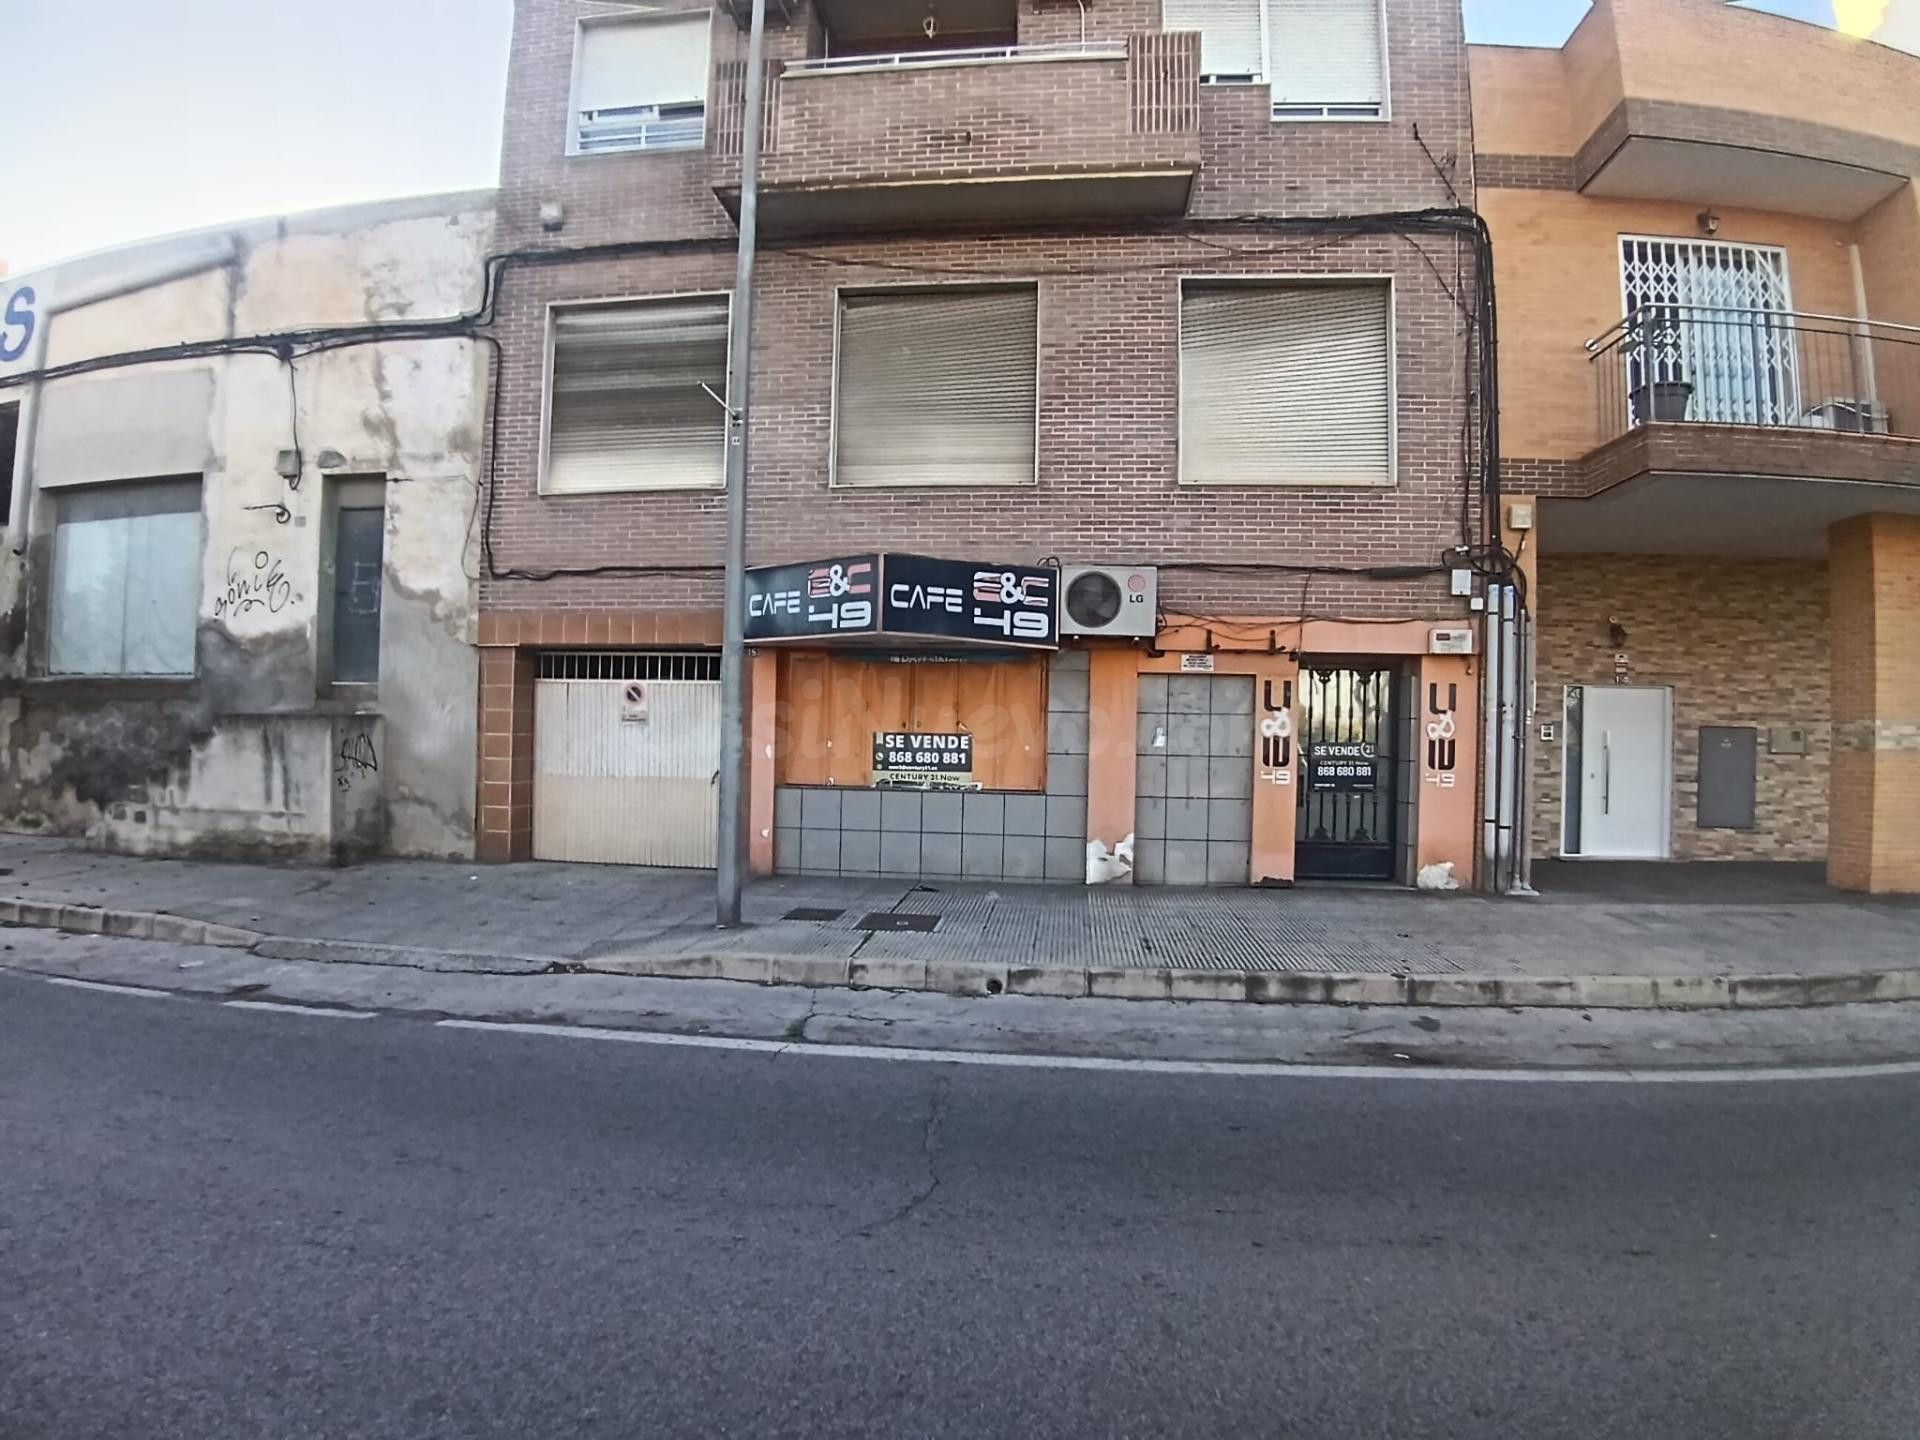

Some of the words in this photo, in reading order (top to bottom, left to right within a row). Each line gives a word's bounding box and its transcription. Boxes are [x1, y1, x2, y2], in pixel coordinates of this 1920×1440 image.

[750, 591, 801, 617] CAFE
[890, 583, 963, 613] CAFE
[1129, 593, 1144, 604] LG
[808, 600, 872, 628] 49
[973, 607, 1049, 638] 49
[885, 735, 905, 748] SE
[910, 736, 969, 749] VENDE
[888, 752, 913, 763] 868
[915, 752, 940, 764] 680
[942, 753, 966, 764] 881
[1314, 746, 1327, 756] SE
[1328, 746, 1360, 756] VENDE
[1317, 766, 1335, 776] 868
[1336, 766, 1354, 776] 680
[1356, 766, 1371, 776] 881
